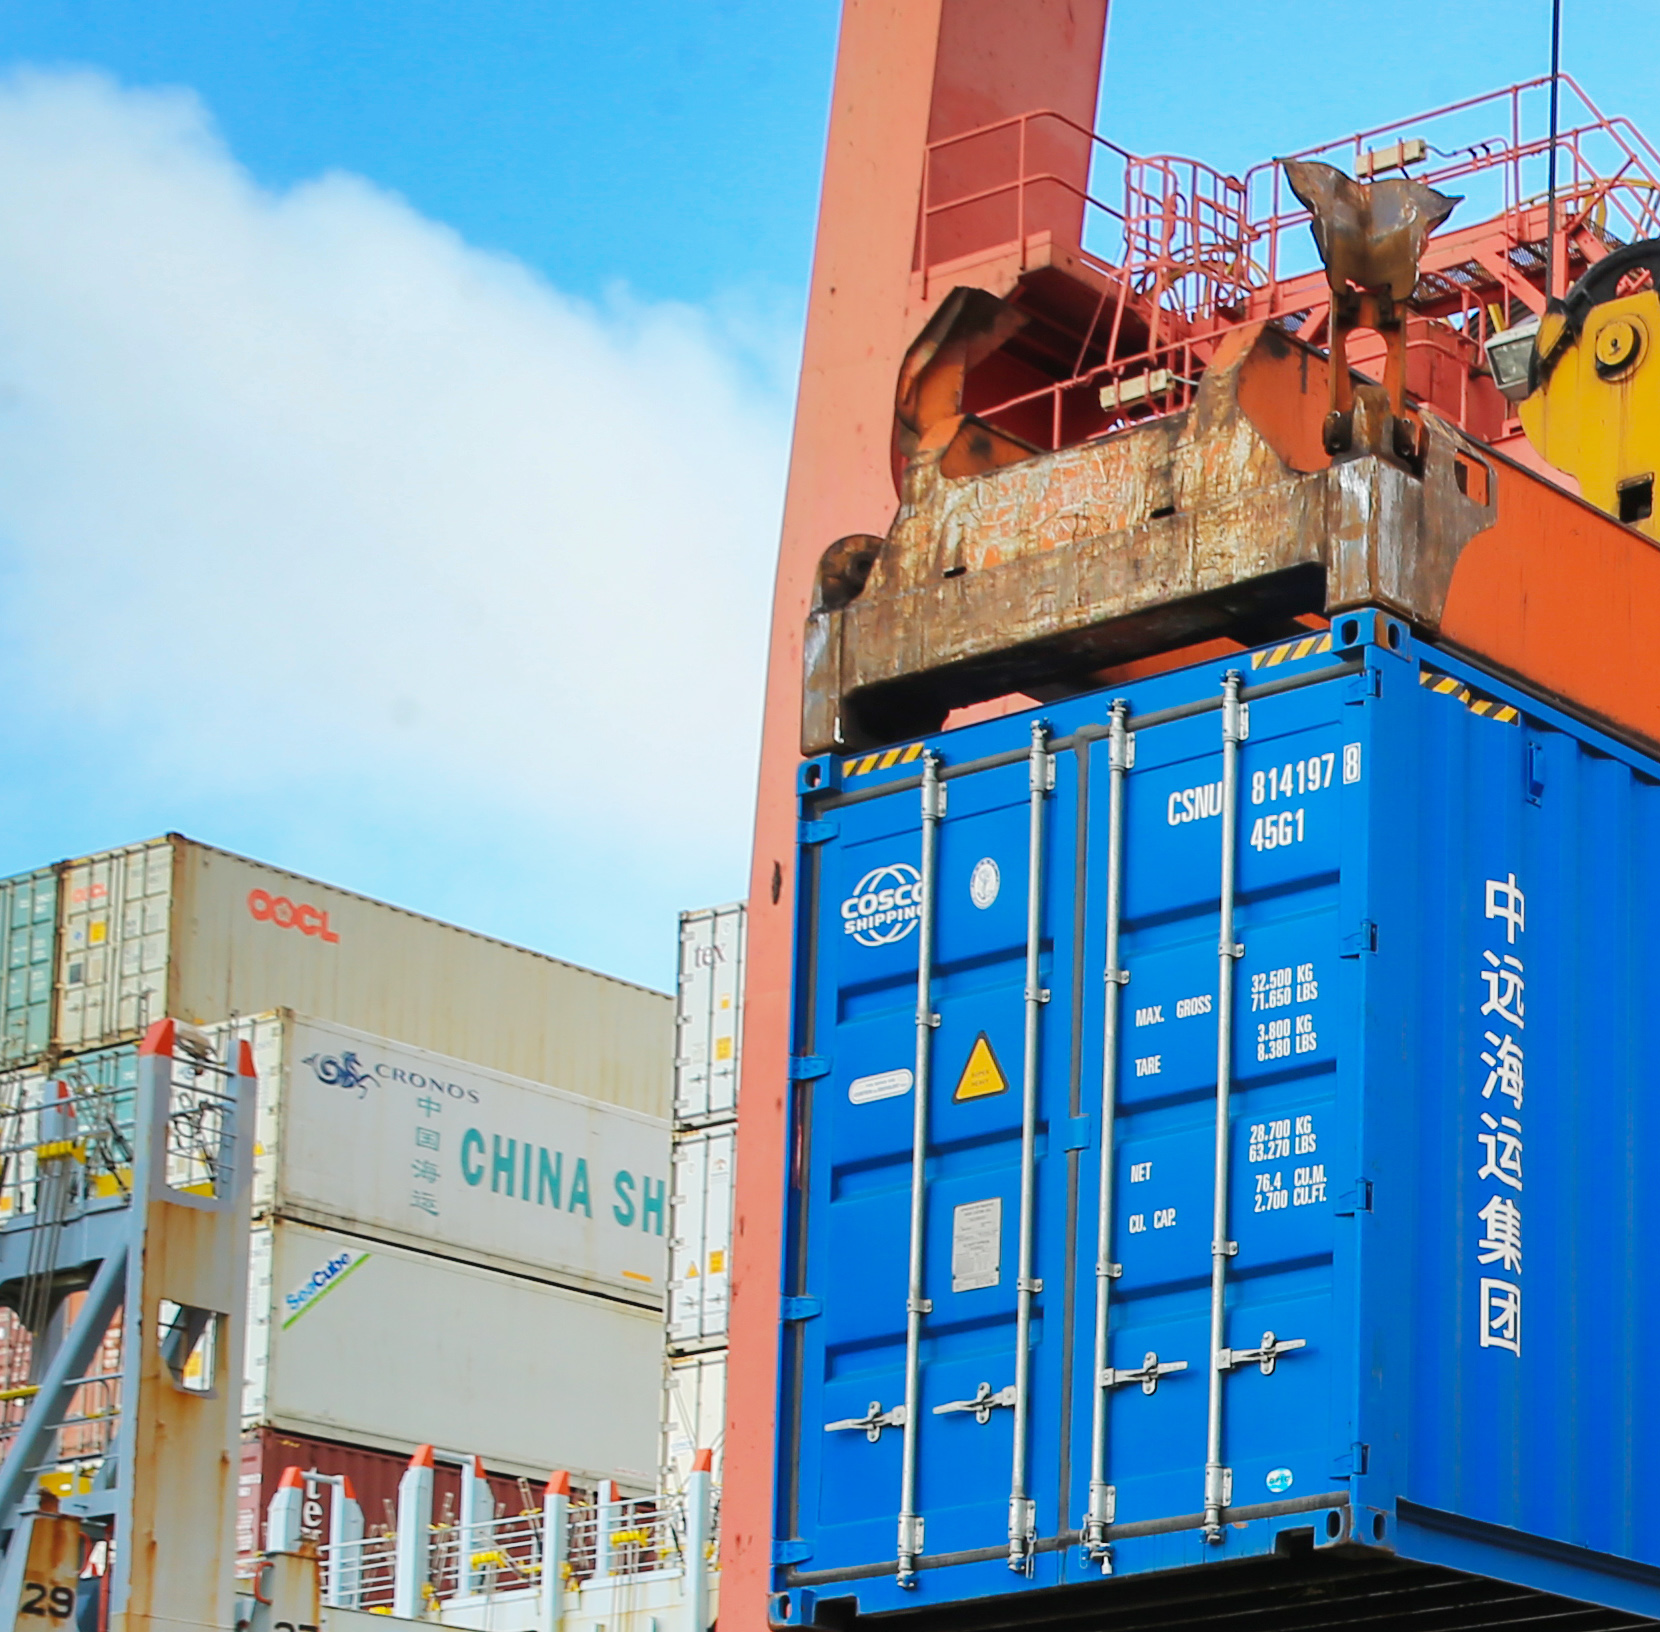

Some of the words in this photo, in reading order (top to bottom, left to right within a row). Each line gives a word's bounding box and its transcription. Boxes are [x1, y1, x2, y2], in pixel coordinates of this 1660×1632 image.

[1167, 780, 1223, 826] CSNU
[1251, 752, 1335, 805] 814197
[1345, 745, 1360, 782] 8
[1250, 808, 1305, 852] 45G1
[246, 888, 340, 944] OOCL
[1251, 967, 1292, 993] 32.500
[1296, 963, 1313, 983] KG
[1135, 1005, 1164, 1027] MAX.
[1176, 994, 1212, 1019] GROSS
[1251, 987, 1292, 1012] 71.650
[1296, 981, 1318, 1003] LBS
[1257, 1018, 1291, 1042] 3.800
[1296, 1014, 1313, 1035] KG
[1257, 1038, 1290, 1062] 8.380
[1296, 1032, 1317, 1054] LBS
[1135, 1055, 1161, 1077] TARE
[374, 1062, 480, 1104] CRONOS
[1250, 1118, 1291, 1144] 28.700
[1295, 1115, 1312, 1135] KG
[1477, 872, 1526, 1358] 中远海运集团
[410, 1095, 442, 1217] 中国海运
[1249, 1138, 1290, 1163] 63.270
[1295, 1134, 1317, 1155] LBS
[460, 1127, 593, 1220] CHINA
[1130, 1162, 1152, 1183] NET
[1255, 1172, 1281, 1193] 76.4
[1254, 1190, 1288, 1213] 2.700
[1129, 1214, 1147, 1234] CU.
[1153, 1208, 1176, 1229] CAP.
[285, 1252, 351, 1311] SeaCube
[21, 1583, 76, 1620] 29
